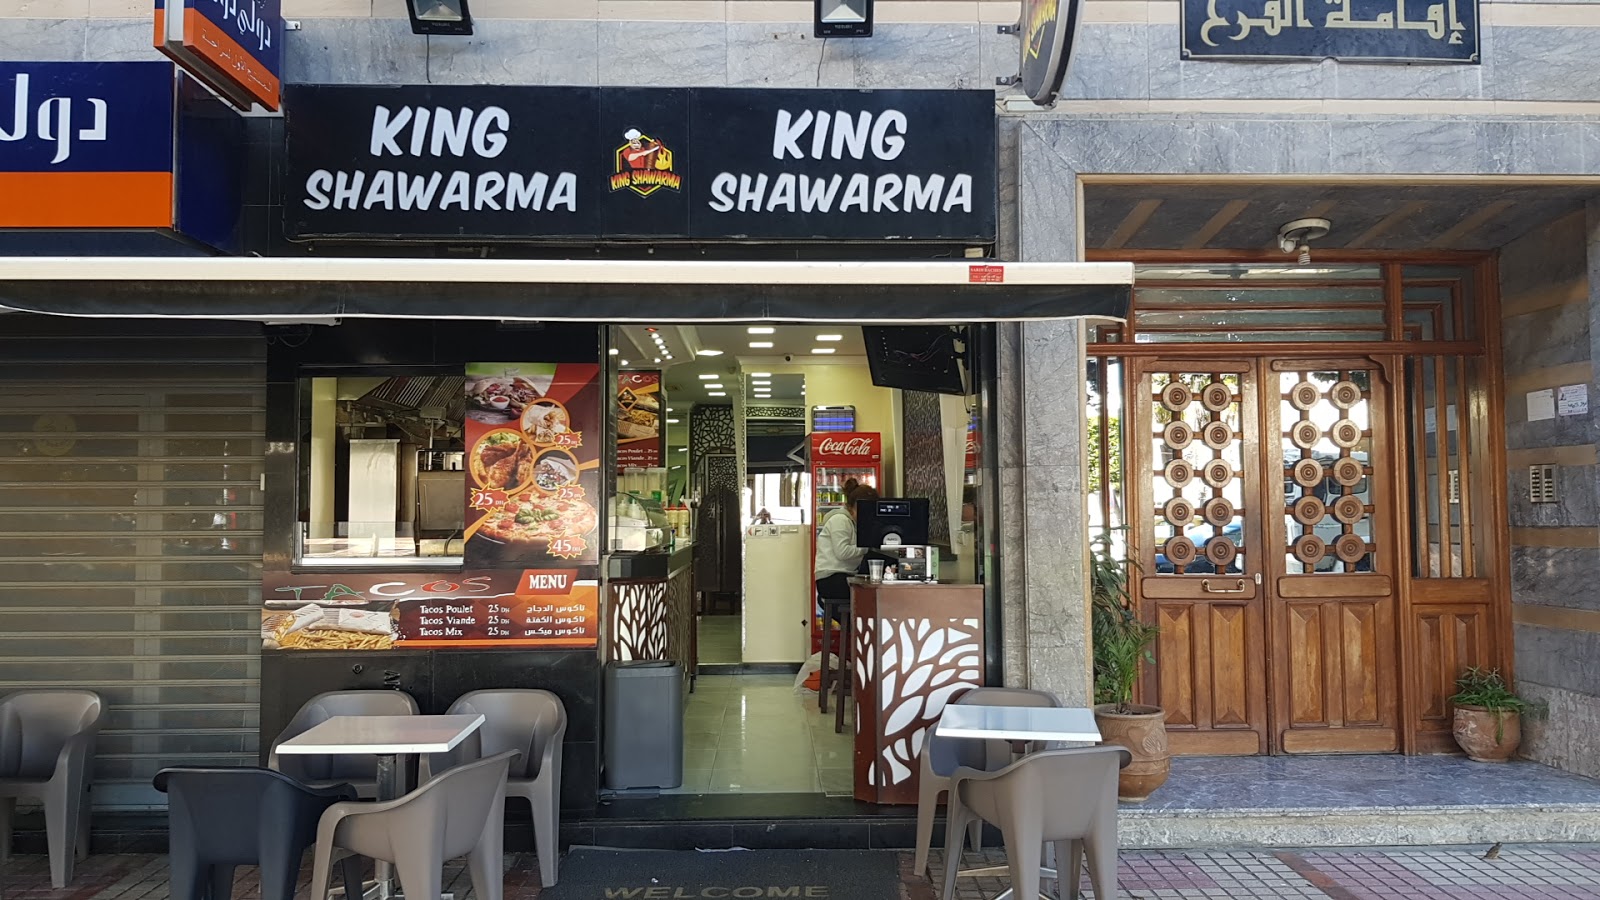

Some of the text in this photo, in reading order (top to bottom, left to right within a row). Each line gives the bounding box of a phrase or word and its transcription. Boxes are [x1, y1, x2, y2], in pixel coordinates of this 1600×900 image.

[370, 106, 509, 158] KING
[773, 109, 908, 160] KING
[611, 169, 681, 190] KING SHAWARMA
[303, 169, 577, 212] SHAWARMA
[708, 172, 973, 213] SHAWARMA
[558, 435, 571, 444] 25
[818, 437, 874, 455] Coca-Cola
[475, 492, 493, 505] 25
[560, 488, 573, 498] 25
[553, 540, 571, 552] 45
[529, 575, 568, 589] MENU
[274, 577, 491, 602] TACOS
[420, 605, 443, 614] Tacos
[446, 604, 473, 613] Poulet
[488, 604, 499, 613] 25
[527, 604, 585, 613] تاكوس الدجاج
[420, 616, 443, 625] Tacos
[446, 615, 476, 624] Viande
[488, 615, 499, 624] 25
[526, 615, 585, 624] تاكوس الكفتة
[420, 628, 443, 637] Tacos
[446, 627, 462, 636] Mix
[488, 627, 499, 636] 25
[525, 627, 585, 636] تاكوس ميكس
[604, 886, 830, 899] WELCOME
